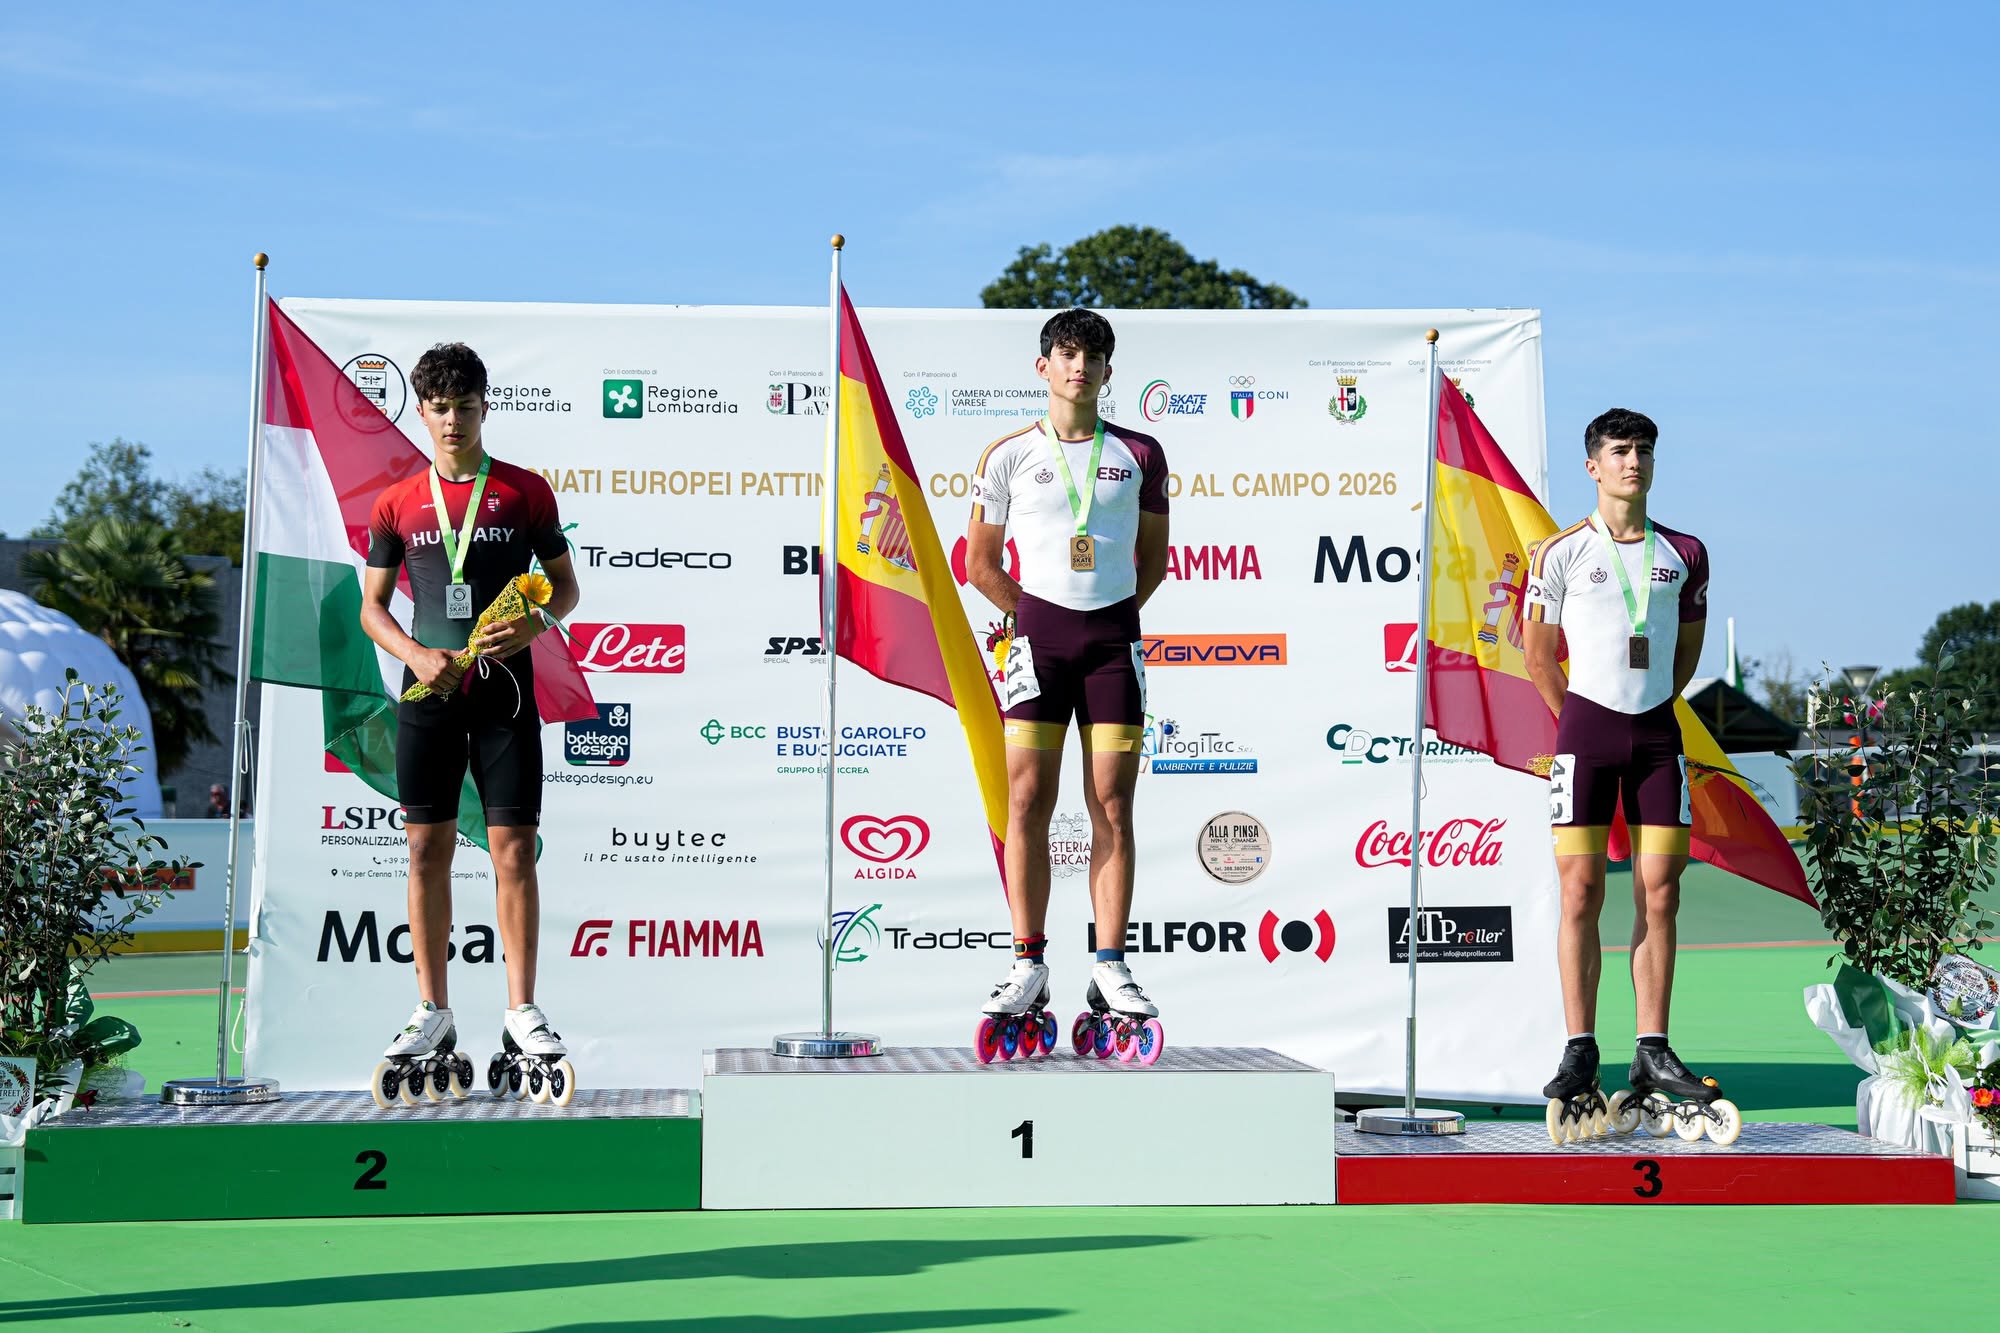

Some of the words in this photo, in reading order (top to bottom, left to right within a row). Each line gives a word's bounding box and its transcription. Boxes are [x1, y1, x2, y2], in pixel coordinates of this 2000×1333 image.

[648, 386, 718, 401] Regione
[1005, 390, 1048, 398] COMMER
[1169, 394, 1207, 404] SKATE
[1258, 391, 1289, 399] CONI
[489, 400, 571, 412] ombardia
[648, 401, 739, 413] Lombardia
[952, 399, 987, 407] VARESE
[952, 408, 982, 416] Futuro
[984, 408, 1019, 418] Impresa
[1020, 408, 1049, 416] Territo
[1097, 467, 1132, 482] ESP
[611, 470, 731, 497] EUROPEI
[1191, 473, 1225, 498] AL
[1232, 472, 1330, 498] CAMPO
[1339, 471, 1398, 496] 2026
[412, 527, 514, 547] HUARY
[580, 546, 732, 569] Tradeco
[578, 624, 684, 672] Lete
[1165, 645, 1279, 662] GIVOVA
[567, 731, 628, 746] bottega
[731, 726, 766, 739] BCC
[841, 727, 926, 740] GAROLFO
[570, 744, 624, 759] design
[777, 744, 787, 756] E
[1155, 763, 1205, 771] AMBIENTE
[1219, 762, 1254, 770] PULIZIE
[1209, 825, 1229, 838] ALLA
[1233, 825, 1259, 838] PINSA
[321, 835, 407, 846] PERSONALIZZIAM
[612, 827, 727, 852] buytec
[583, 853, 594, 863] il
[600, 854, 619, 863] PC
[625, 854, 666, 863] usato
[671, 853, 759, 866] intelligente
[476, 872, 488, 880] (VA)
[854, 868, 917, 879] ALGIDA
[628, 920, 764, 957] FIAMMA
[884, 928, 1012, 950] Tradec
[1443, 950, 1501, 958] info@atproller.com
[1011, 1120, 1034, 1158] 1
[354, 1150, 387, 1189] 2
[1633, 1160, 1663, 1198] 3
